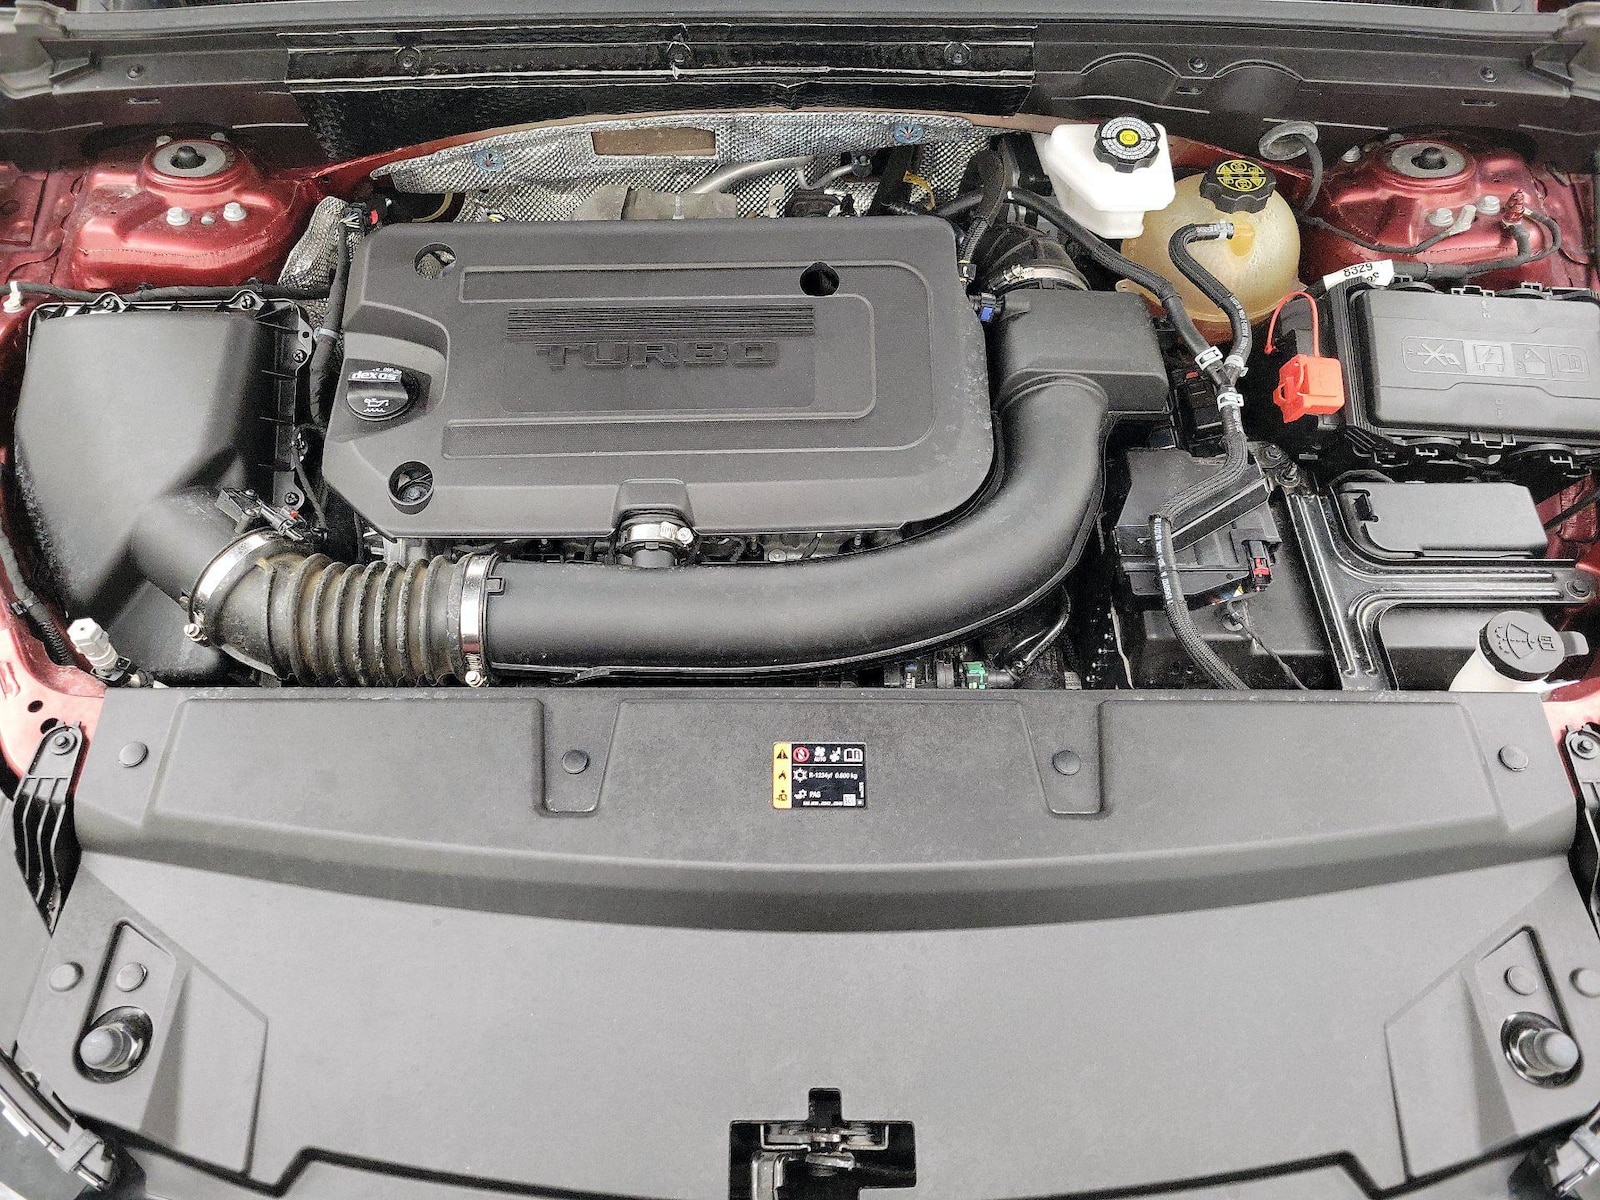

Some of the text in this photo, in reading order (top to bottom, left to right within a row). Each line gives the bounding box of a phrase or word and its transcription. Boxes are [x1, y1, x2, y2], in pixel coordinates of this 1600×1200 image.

[1343, 263, 1373, 277] 8329
[535, 340, 778, 369] TURBO
[351, 370, 398, 380] dexos
